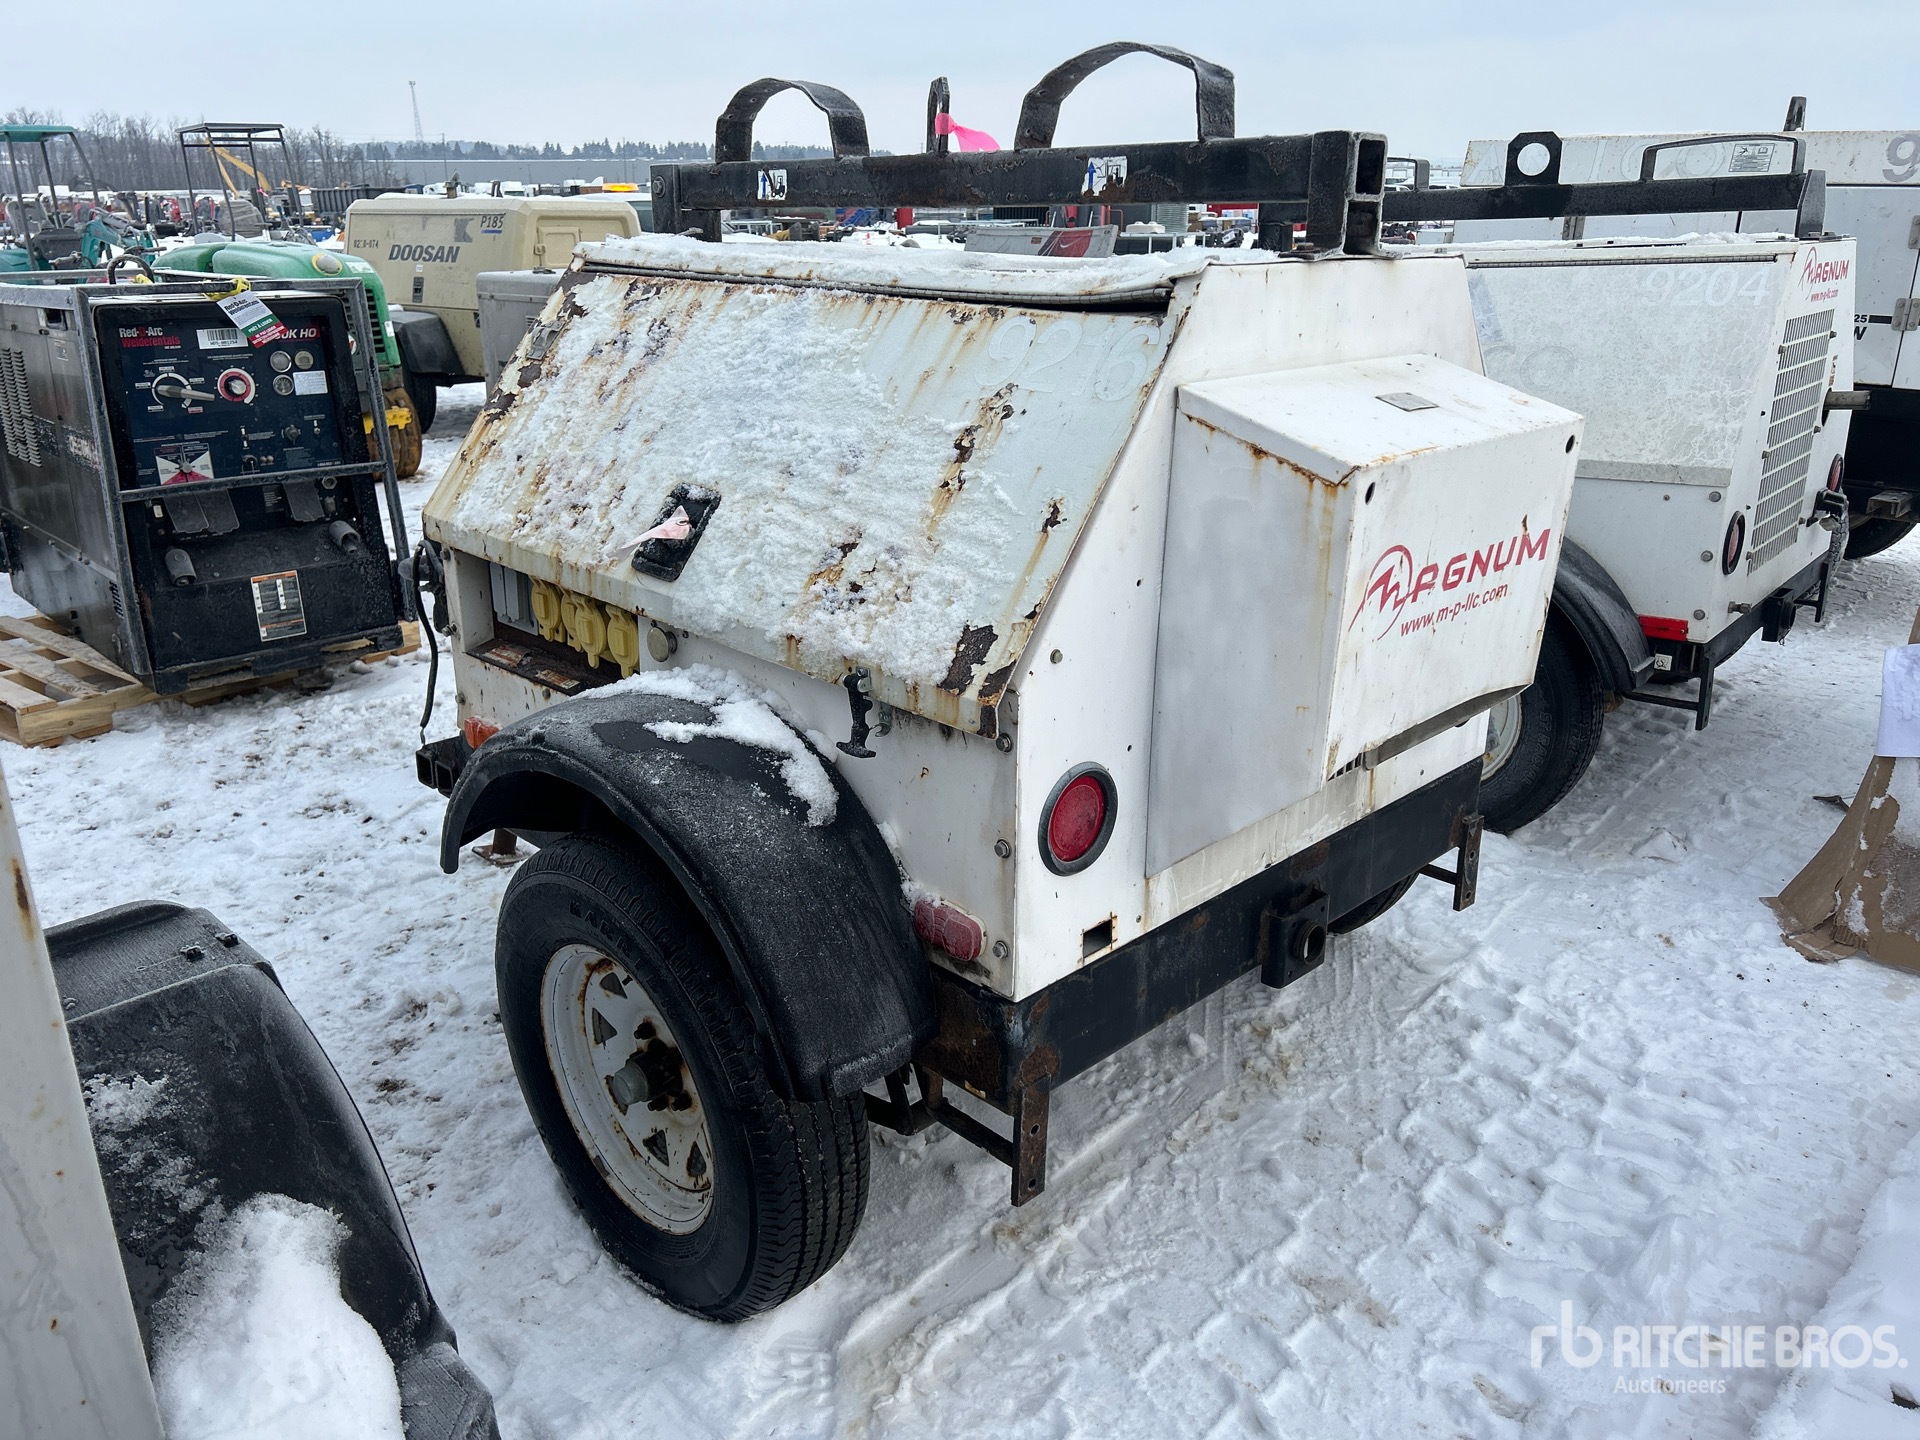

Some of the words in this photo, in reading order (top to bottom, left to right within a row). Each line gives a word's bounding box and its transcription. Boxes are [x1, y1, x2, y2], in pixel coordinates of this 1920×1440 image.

[480, 215, 504, 229] P185
[388, 244, 461, 263] DOOSAN
[1641, 265, 1770, 307] 9204
[1358, 528, 1551, 626] MAGNUM
[1400, 583, 1509, 637] www.m-p-llc.com
